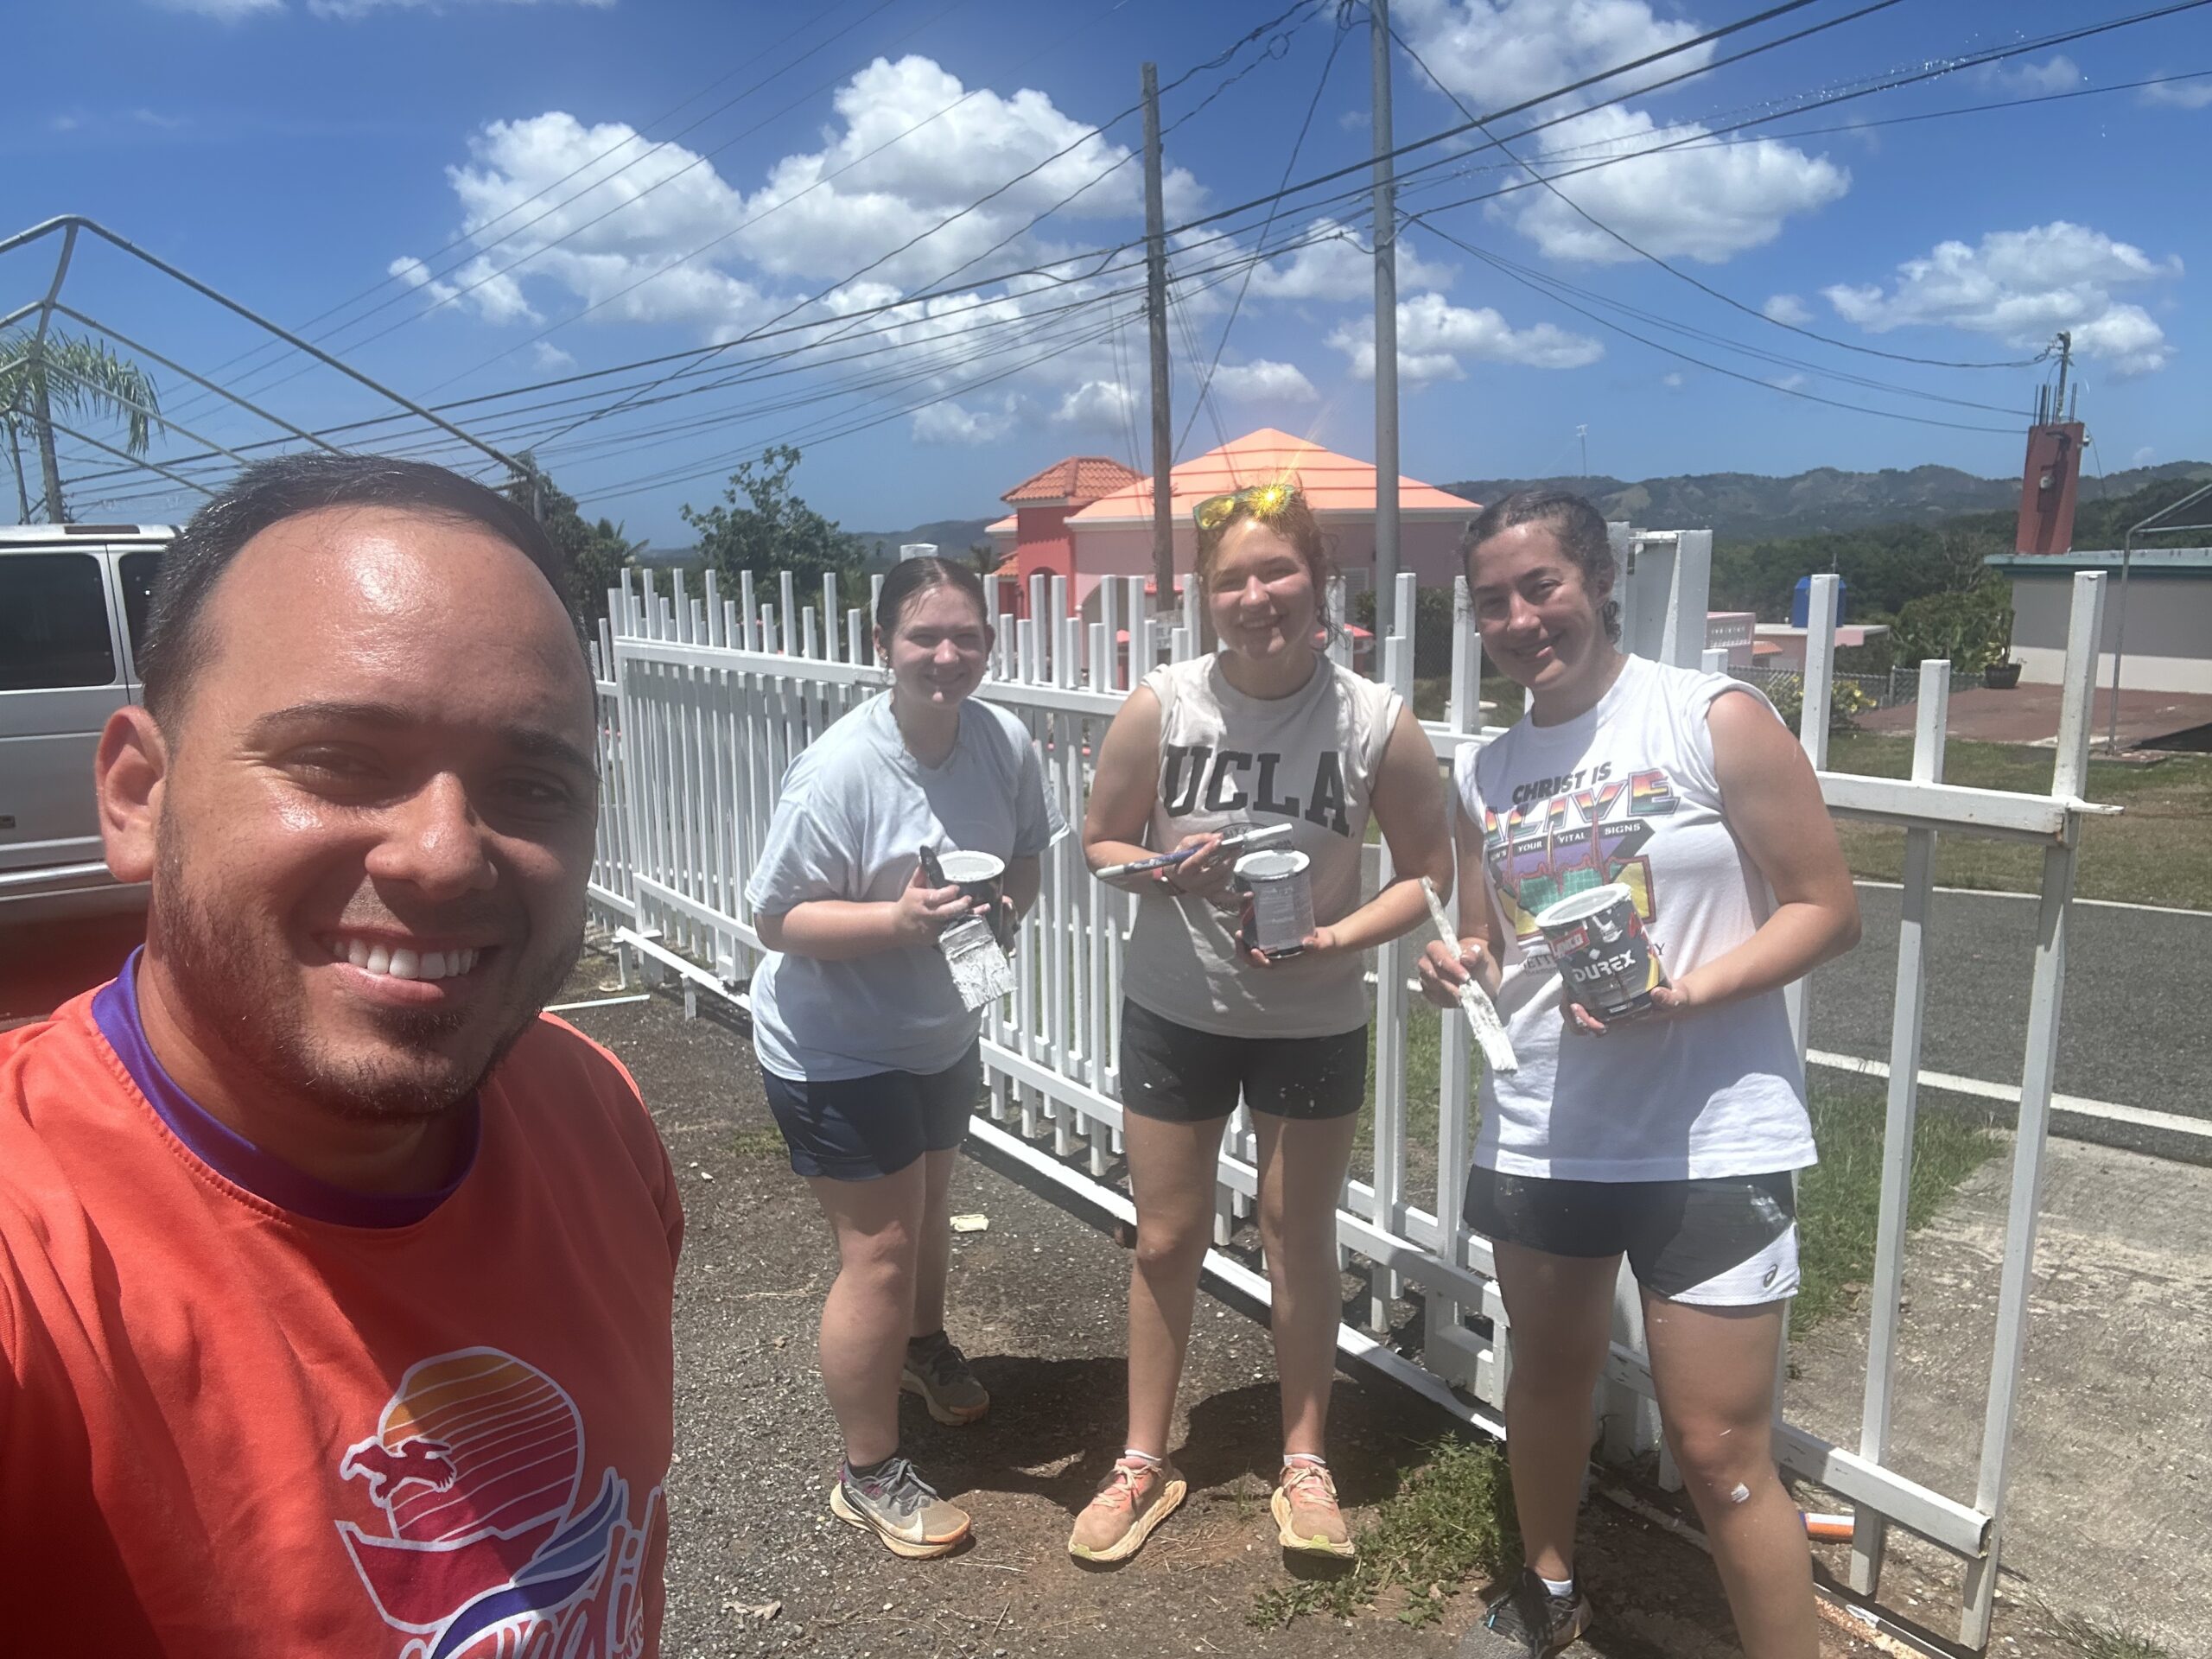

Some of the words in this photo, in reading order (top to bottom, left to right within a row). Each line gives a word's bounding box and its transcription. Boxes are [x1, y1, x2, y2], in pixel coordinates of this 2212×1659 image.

[1164, 744, 1350, 837] UCLA
[1513, 770, 1586, 804] CHRIST
[1592, 761, 1612, 785] IS
[1518, 841, 1542, 853] YOUR
[1558, 832, 1586, 844] VITAL
[1605, 823, 1641, 836] SIGNS
[1572, 950, 1636, 982] DUREX
